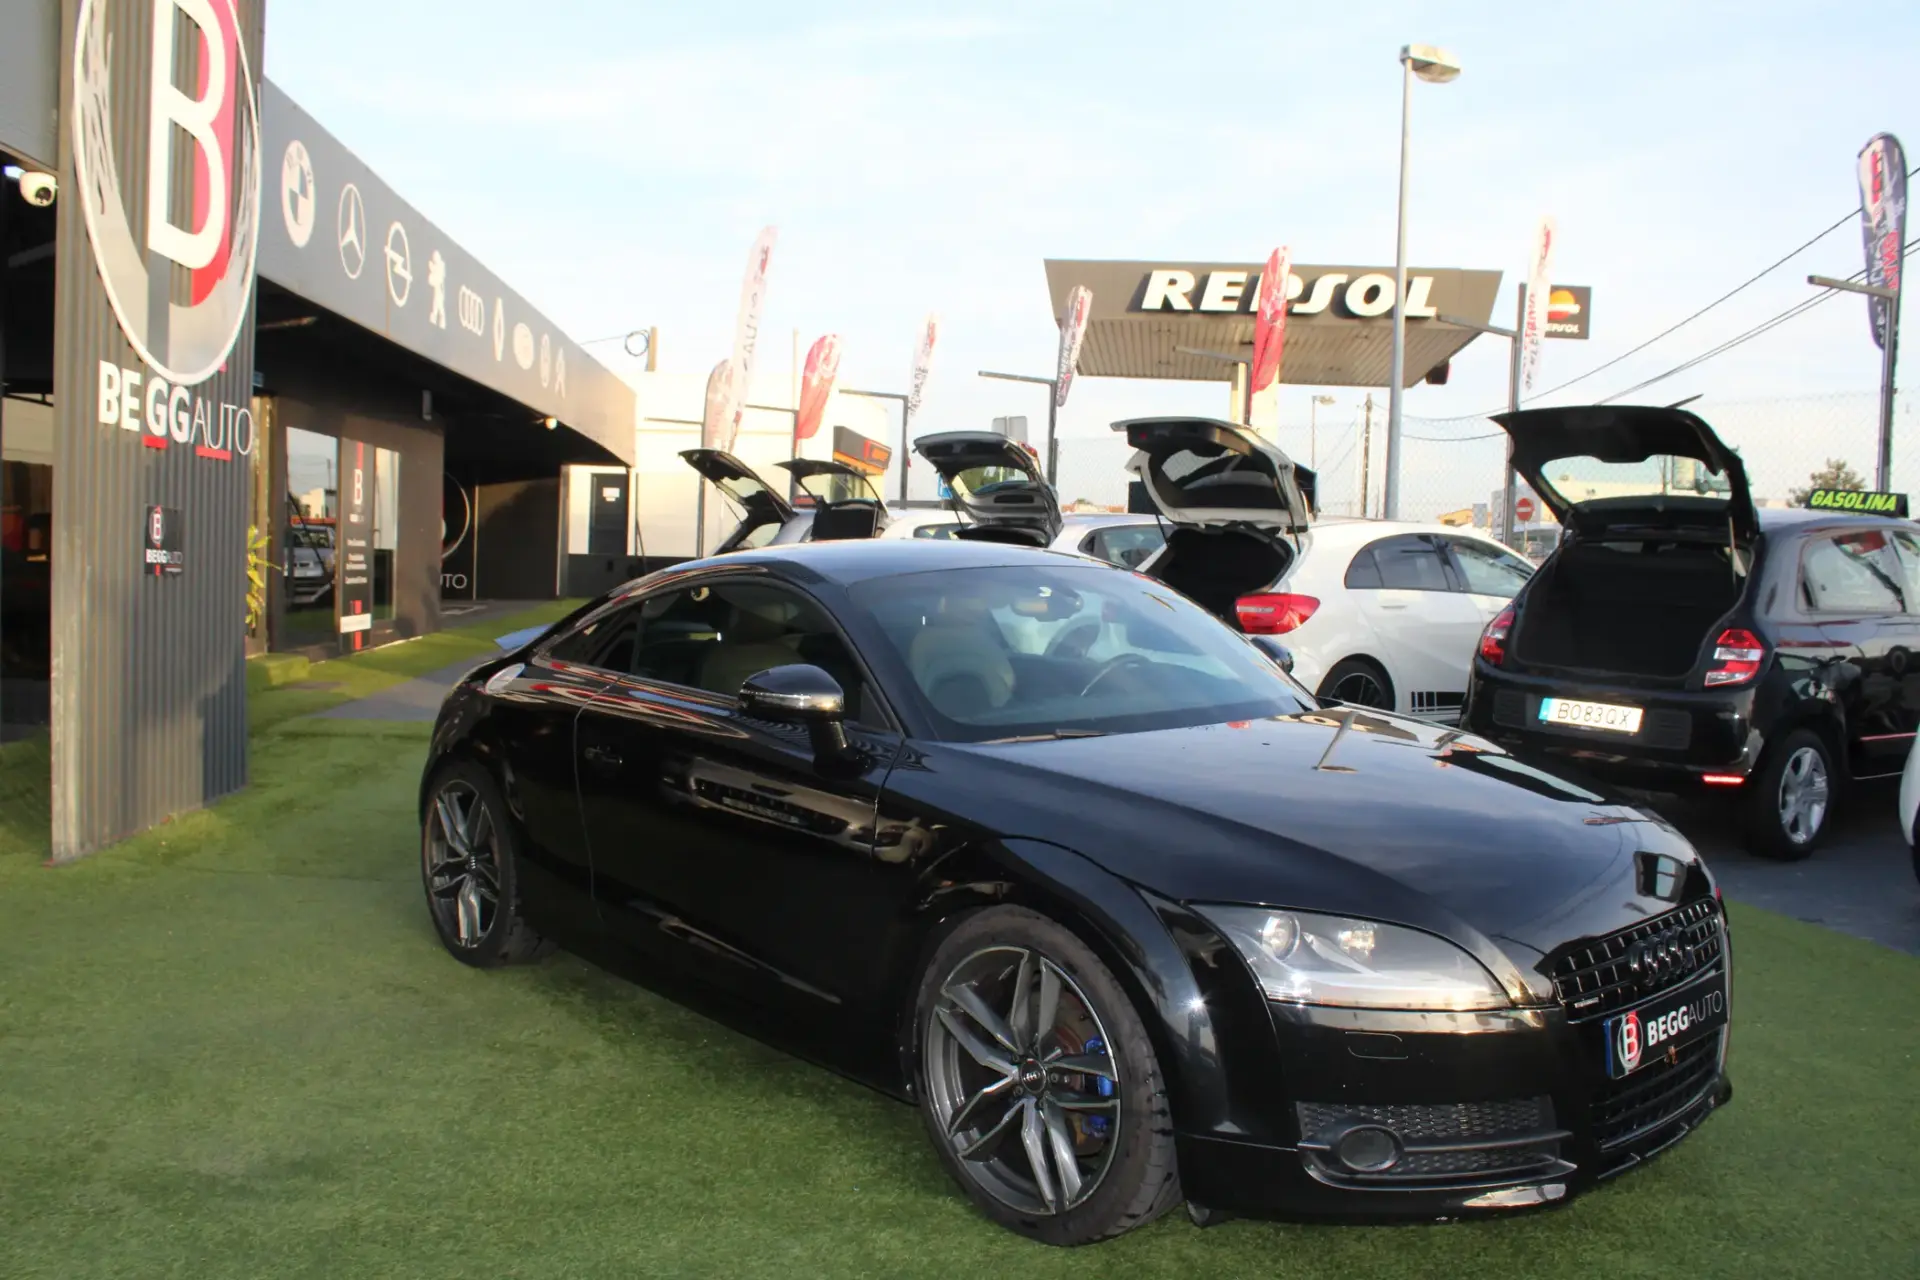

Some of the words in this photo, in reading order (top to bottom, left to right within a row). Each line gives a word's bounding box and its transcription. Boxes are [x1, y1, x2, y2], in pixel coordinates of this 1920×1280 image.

[1142, 270, 1438, 317] REPSOL
[99, 360, 253, 455] BEGGAUTO
[1810, 490, 1897, 511] GASOLINA
[1647, 991, 1722, 1046] BEGGAUTO
